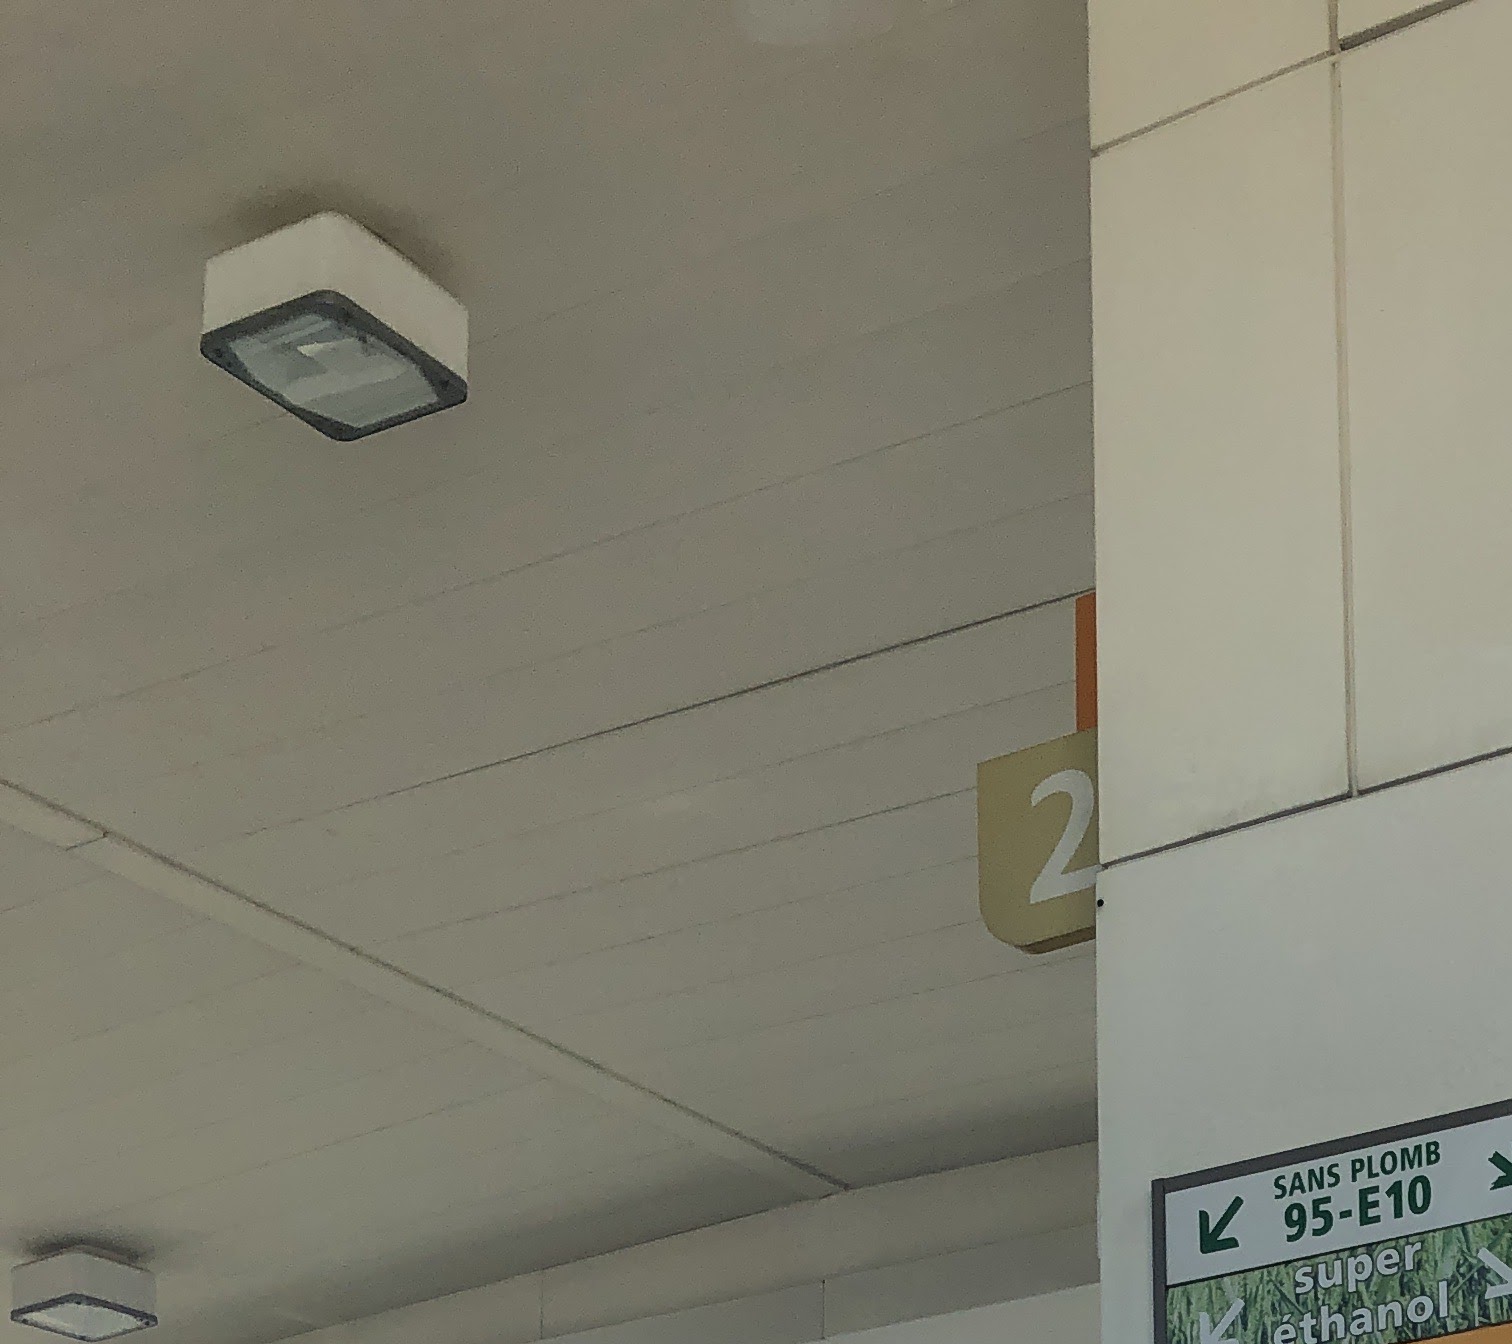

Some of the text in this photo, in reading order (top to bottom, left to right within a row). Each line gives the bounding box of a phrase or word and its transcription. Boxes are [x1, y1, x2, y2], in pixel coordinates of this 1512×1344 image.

[1027, 767, 1098, 905] 2
[1273, 1139, 1441, 1200] SANS PLOMB
[1284, 1174, 1432, 1242] 95-E10
[1295, 1242, 1423, 1295] super
